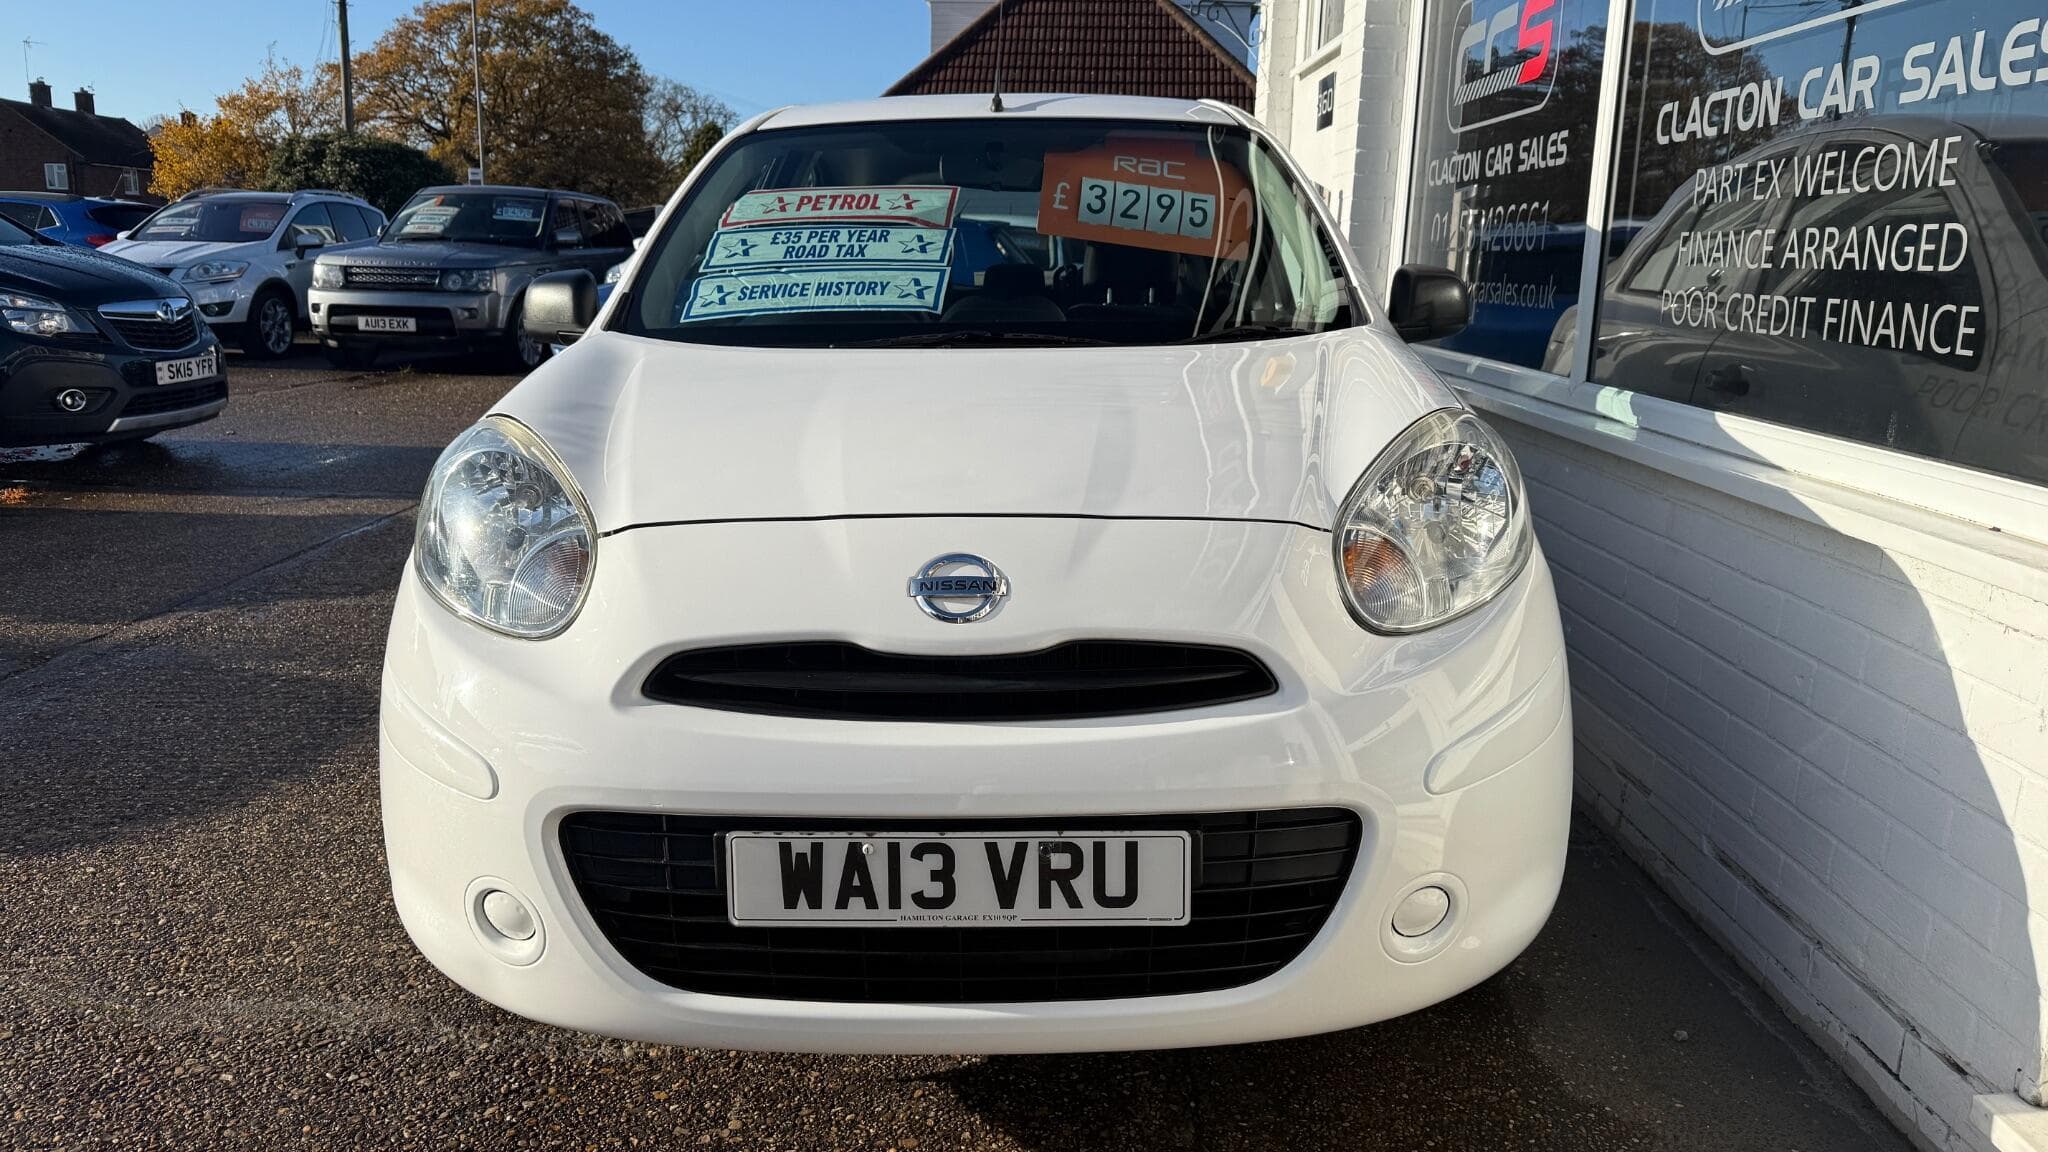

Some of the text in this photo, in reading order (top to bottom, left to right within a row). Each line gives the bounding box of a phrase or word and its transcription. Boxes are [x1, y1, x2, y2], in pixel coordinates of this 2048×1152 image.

[1656, 76, 1784, 145] CLACTON
[1798, 55, 1880, 120] CAR
[1428, 130, 1569, 186] CLACTON CAR SALES
[1693, 136, 1962, 205] PART EX WELCOME
[795, 193, 881, 212] PETROL
[1086, 184, 1209, 228] 3295
[770, 229, 891, 245] £35 PER YEAR
[782, 244, 868, 260] ROAD TAX
[1676, 222, 1969, 273] FINANCE ARRANGED
[737, 280, 892, 302] SERVICE HISTORY
[365, 319, 409, 329] AU13 EXK
[1661, 289, 1980, 357] POOR CREDIT FINANCE
[167, 359, 214, 380] SK15 YFR
[920, 580, 997, 591] NISSAN
[778, 840, 1139, 910] WA13 VRU
